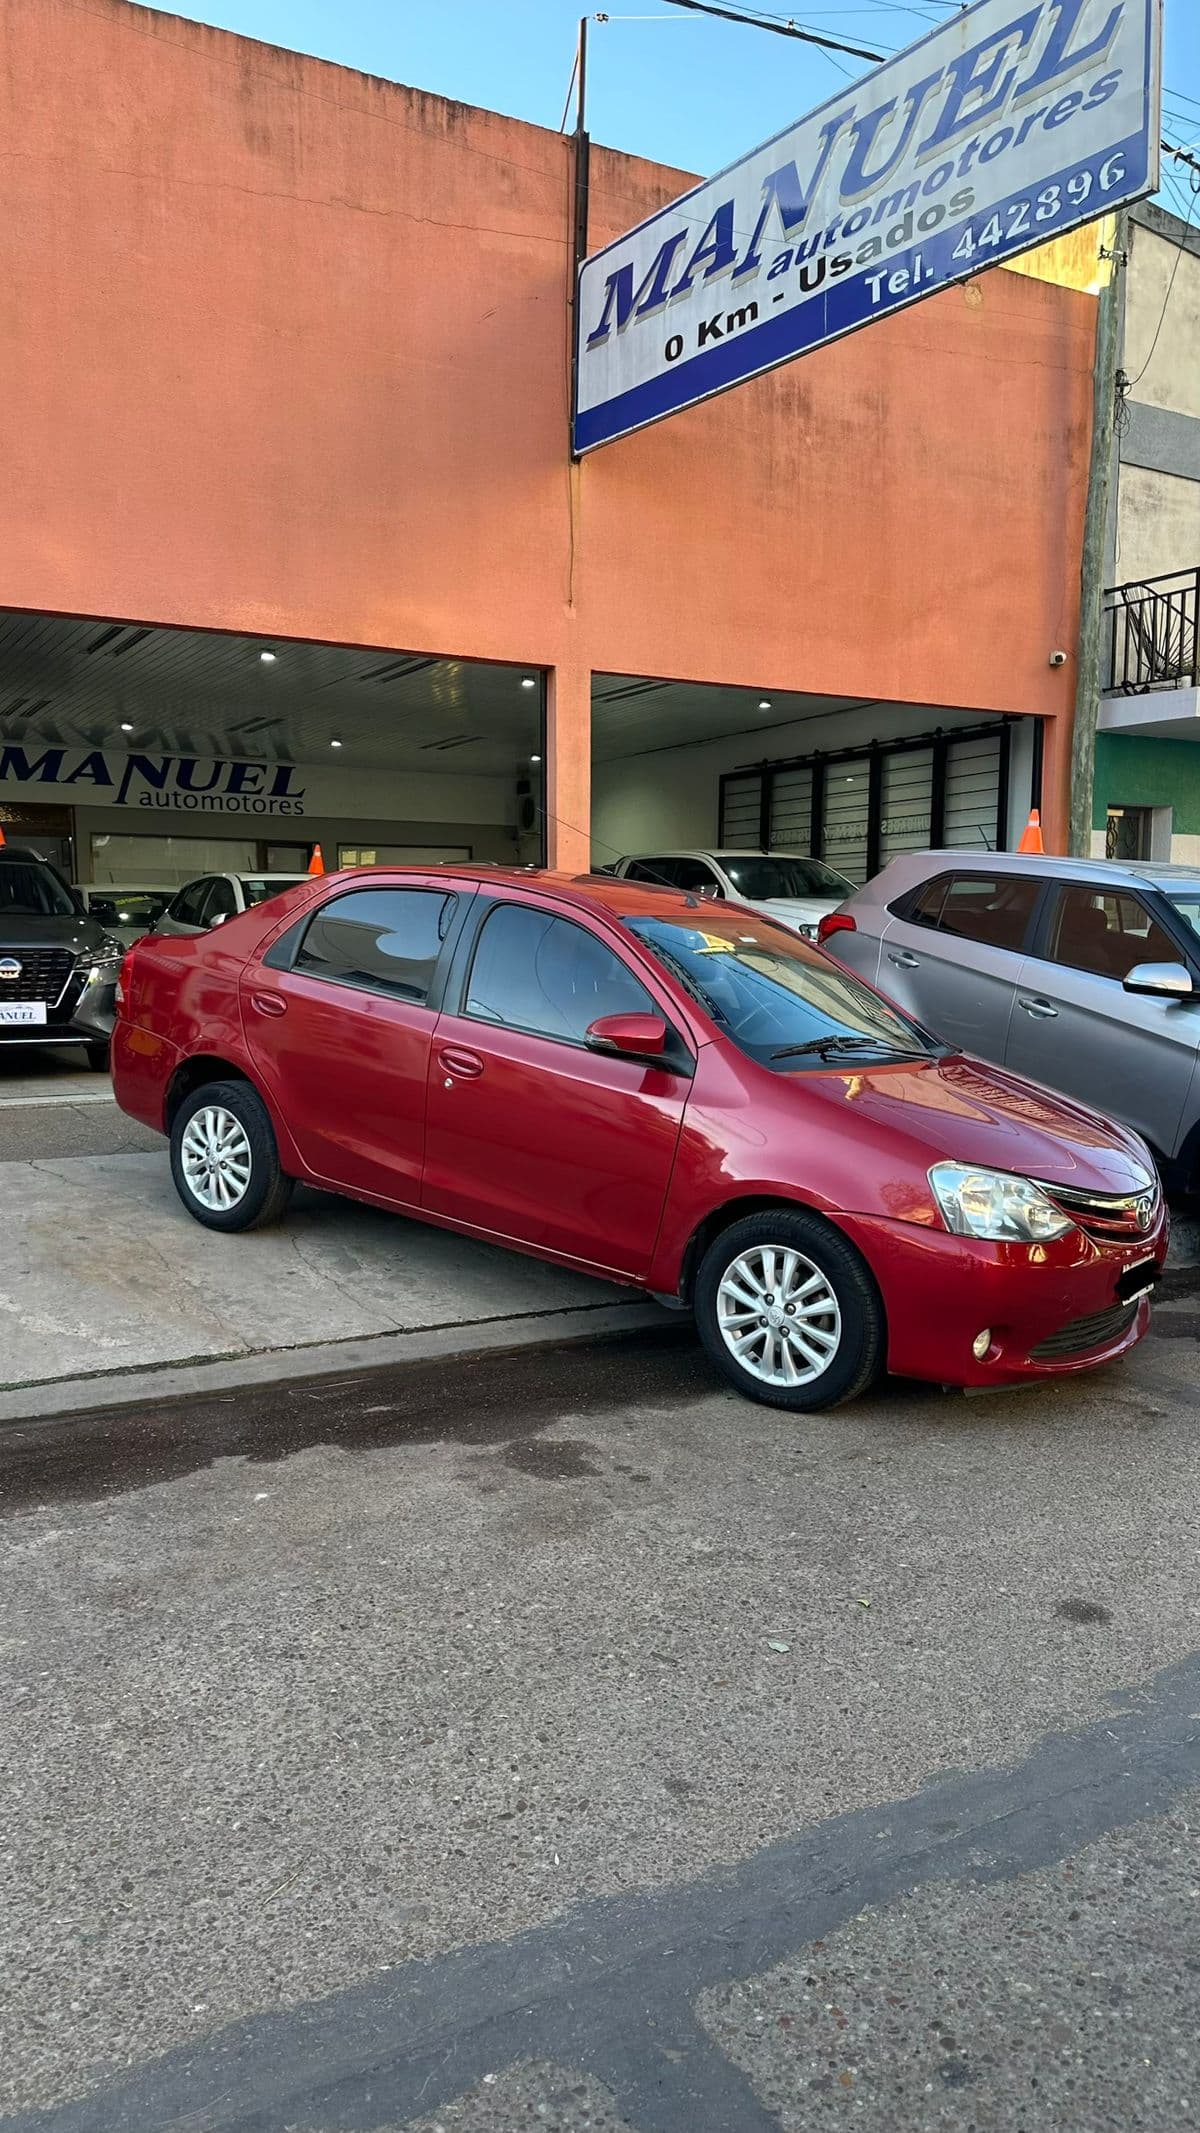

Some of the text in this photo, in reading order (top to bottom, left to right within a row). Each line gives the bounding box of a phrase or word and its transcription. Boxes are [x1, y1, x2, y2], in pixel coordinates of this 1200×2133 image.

[586, 0, 1125, 351] MANUEL
[766, 69, 1123, 281] automotores
[865, 152, 1126, 303] Tel. 442896
[665, 334, 684, 362] 0
[697, 301, 758, 347] Km
[799, 186, 975, 292] Usados
[0, 746, 306, 804] MANUEL
[139, 790, 305, 815] automotores
